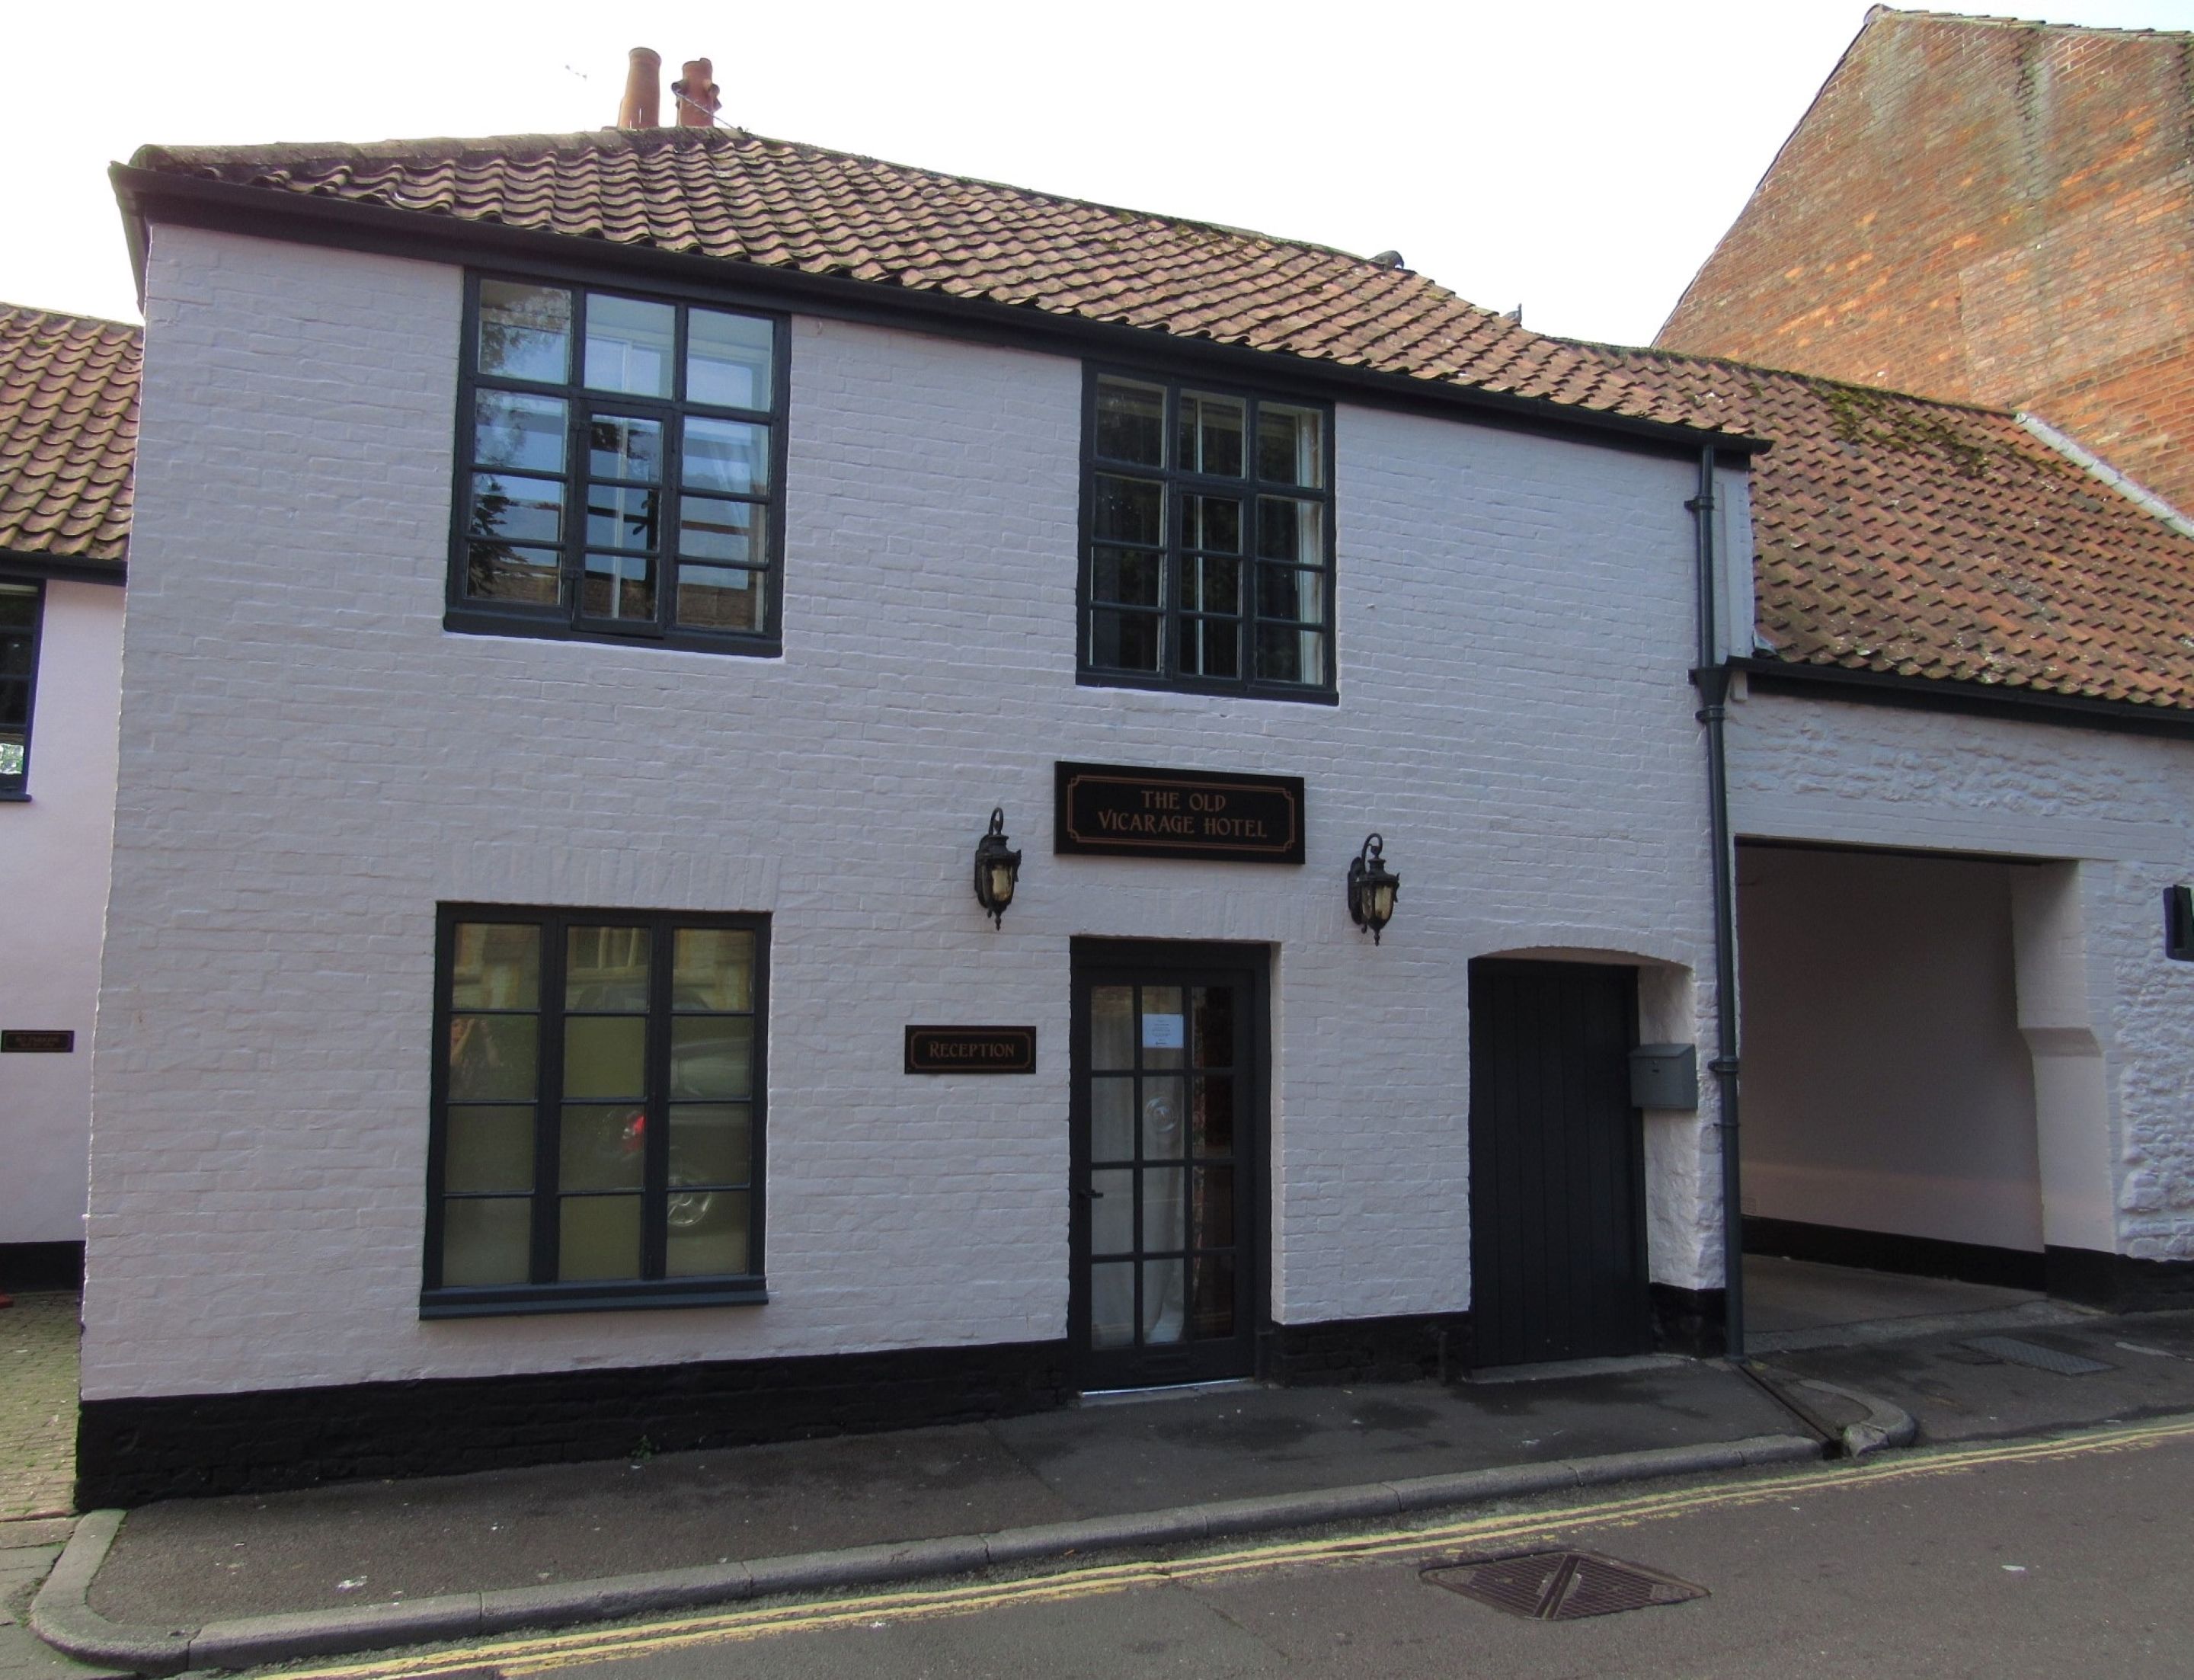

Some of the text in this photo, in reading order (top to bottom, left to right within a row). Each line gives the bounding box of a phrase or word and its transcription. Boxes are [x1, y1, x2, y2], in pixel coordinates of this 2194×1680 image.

[1142, 790, 1226, 812] THE OLD
[1098, 809, 1267, 838] VICARAGE HOTEL
[929, 1041, 1015, 1058] RECEPTION
